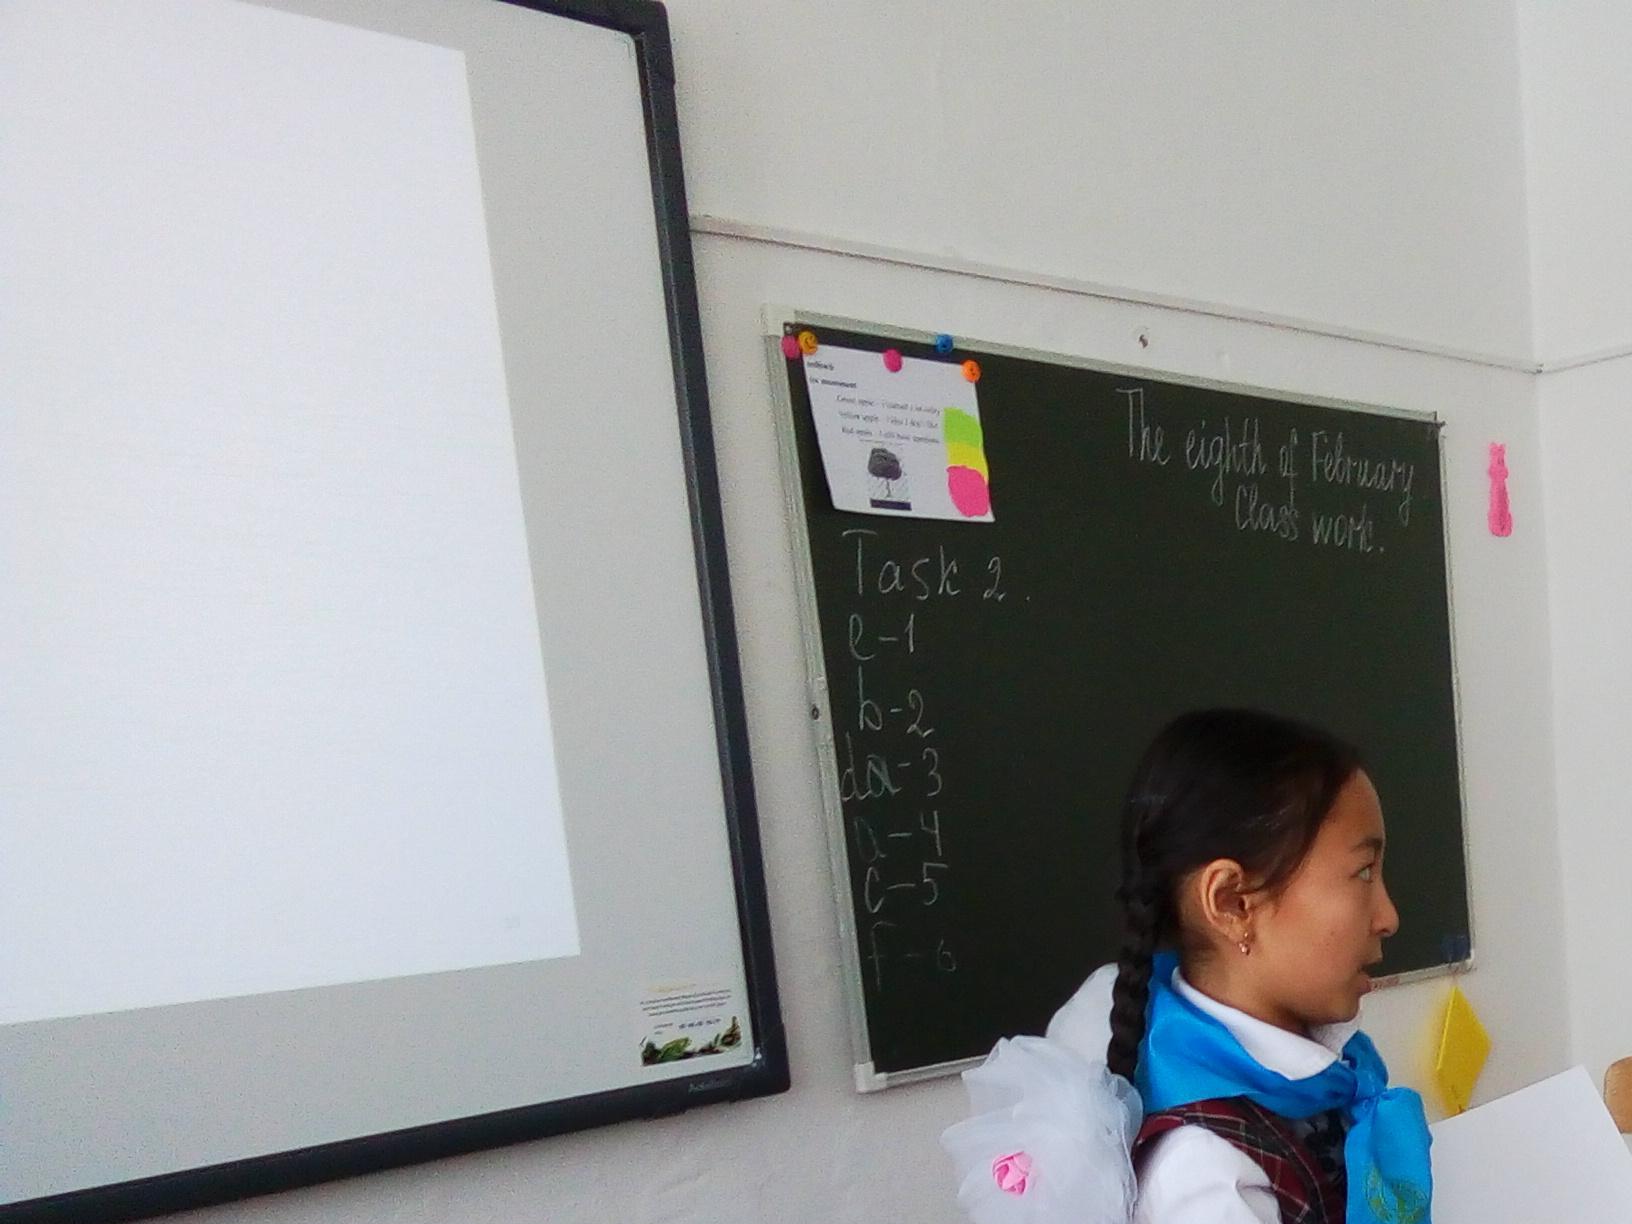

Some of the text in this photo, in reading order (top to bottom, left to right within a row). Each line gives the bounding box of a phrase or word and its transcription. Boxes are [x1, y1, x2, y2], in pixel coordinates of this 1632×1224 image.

[1115, 387, 1415, 527] The eighth of February
[1235, 482, 1300, 541] Class
[841, 528, 961, 600] Task
